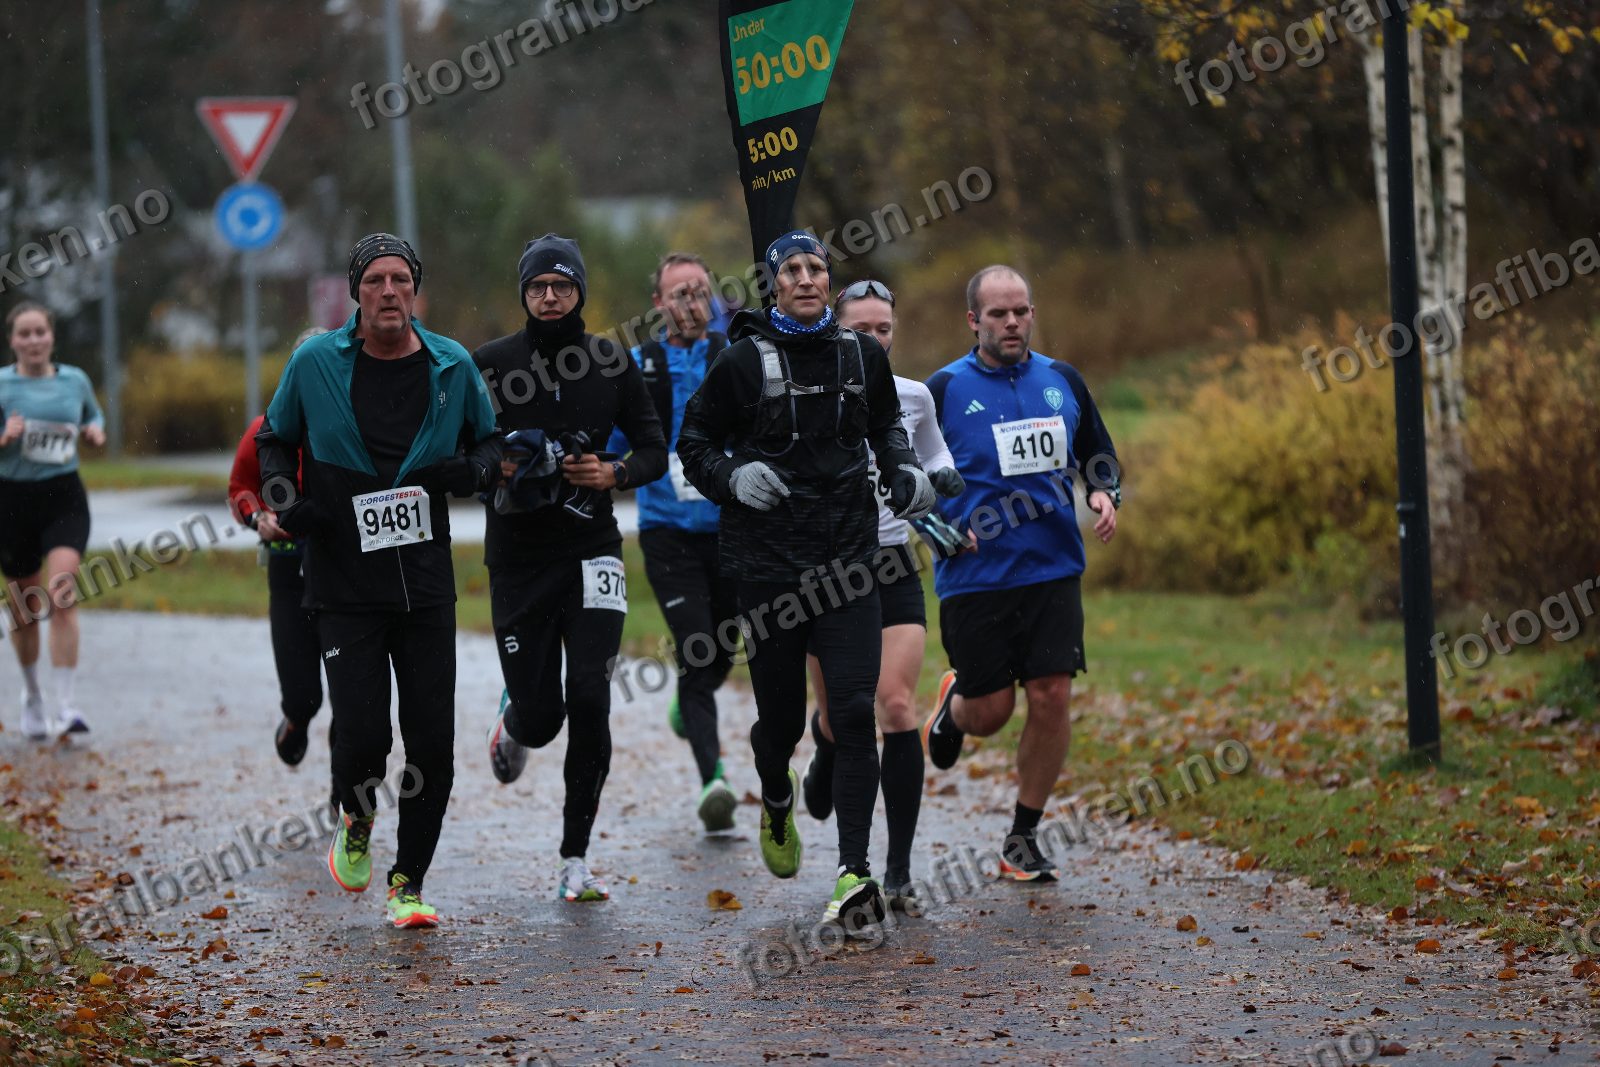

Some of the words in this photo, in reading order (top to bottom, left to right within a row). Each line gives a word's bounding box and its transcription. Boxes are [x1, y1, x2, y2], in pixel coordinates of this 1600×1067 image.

[736, 34, 830, 94] 50:00
[747, 126, 799, 164] 5:00
[1012, 430, 1055, 460] 410
[363, 500, 422, 536] 9481
